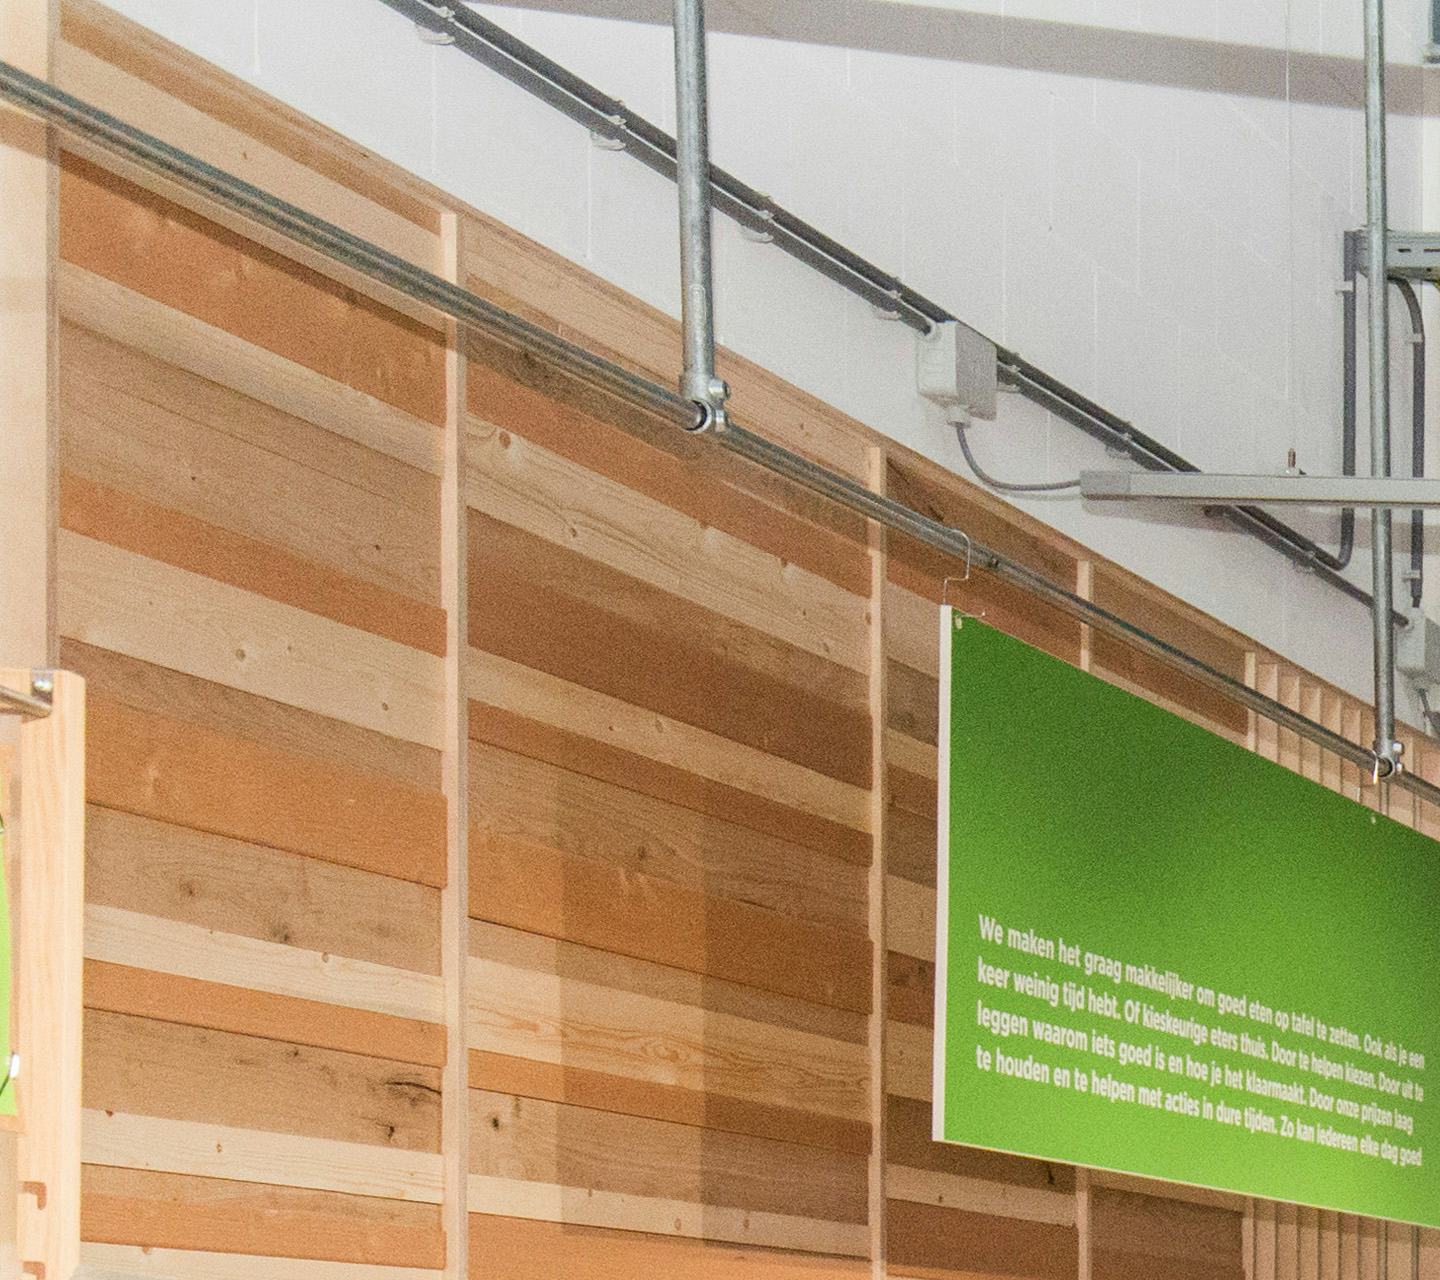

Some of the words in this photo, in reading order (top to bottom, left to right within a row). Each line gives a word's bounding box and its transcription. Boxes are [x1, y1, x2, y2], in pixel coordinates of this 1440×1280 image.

[977, 956, 1010, 989] keer
[1013, 972, 1058, 1007] weinig
[1063, 982, 1084, 1012] tijd
[1088, 988, 1121, 1020] hebt.
[1124, 999, 1141, 1024] Of
[1142, 1003, 1207, 1046] kieskeurige
[1210, 1027, 1237, 1051] eters
[1240, 1033, 1269, 1060] thuis.
[1271, 1040, 1297, 1067] Door
[1299, 1050, 1309, 1071] te
[1311, 1053, 1343, 1080] helpen
[1345, 1063, 1376, 1089] kiezen.
[1379, 1072, 1400, 1095] Door
[1402, 1080, 1413, 1099] uit
[1415, 1083, 1424, 1101] te
[979, 914, 1003, 944] We
[1008, 929, 1054, 960] maken
[1058, 938, 1080, 967] het
[1085, 952, 1121, 984] graag
[1126, 964, 1193, 1000] makkelijker
[1197, 985, 1215, 1007] om
[1218, 996, 1247, 1017] goed
[1249, 1000, 1272, 1024] eten
[1276, 1010, 1289, 1032] op
[1292, 1012, 1314, 1037] tafel
[1317, 1020, 1327, 1040] te
[1329, 1026, 1361, 1050] zetten.
[1364, 1033, 1383, 1057] Ook
[1385, 1041, 1397, 1062] als
[1398, 1044, 1407, 1066] je
[1409, 1051, 1424, 1069] een
[976, 1044, 991, 1071] te
[996, 1047, 1049, 1084] houden
[1054, 1067, 1070, 1088] en
[1074, 1068, 1088, 1092] te
[1092, 1070, 1135, 1103] helpen
[1139, 1085, 1162, 1108] met
[1165, 1092, 1200, 1117] acties
[1202, 1097, 1213, 1119] in
[1216, 1101, 1241, 1126] dure
[1244, 1107, 1277, 1134] tijden.
[1280, 1115, 1294, 1137] Zo
[1297, 1119, 1314, 1141] kan
[1317, 1124, 1358, 1151] iedereen
[1360, 1135, 1379, 1156] elke
[1381, 1139, 1397, 1165] dag
[1400, 1148, 1422, 1166] goed
[977, 999, 1028, 1037] leggen
[1032, 1020, 1088, 1051] waarom
[1092, 1029, 1115, 1058] iets
[1119, 1042, 1152, 1066] goed
[1155, 1045, 1165, 1071] is
[1168, 1059, 1183, 1074] en
[1186, 1055, 1208, 1080] hoe
[1210, 1061, 1221, 1087] je
[1225, 1064, 1243, 1090] het
[1246, 1069, 1307, 1105] klaarmaakt.
[1310, 1087, 1334, 1112] Door
[1336, 1098, 1359, 1118] onze
[1361, 1103, 1392, 1126] prijzen
[1394, 1108, 1413, 1135] laag
